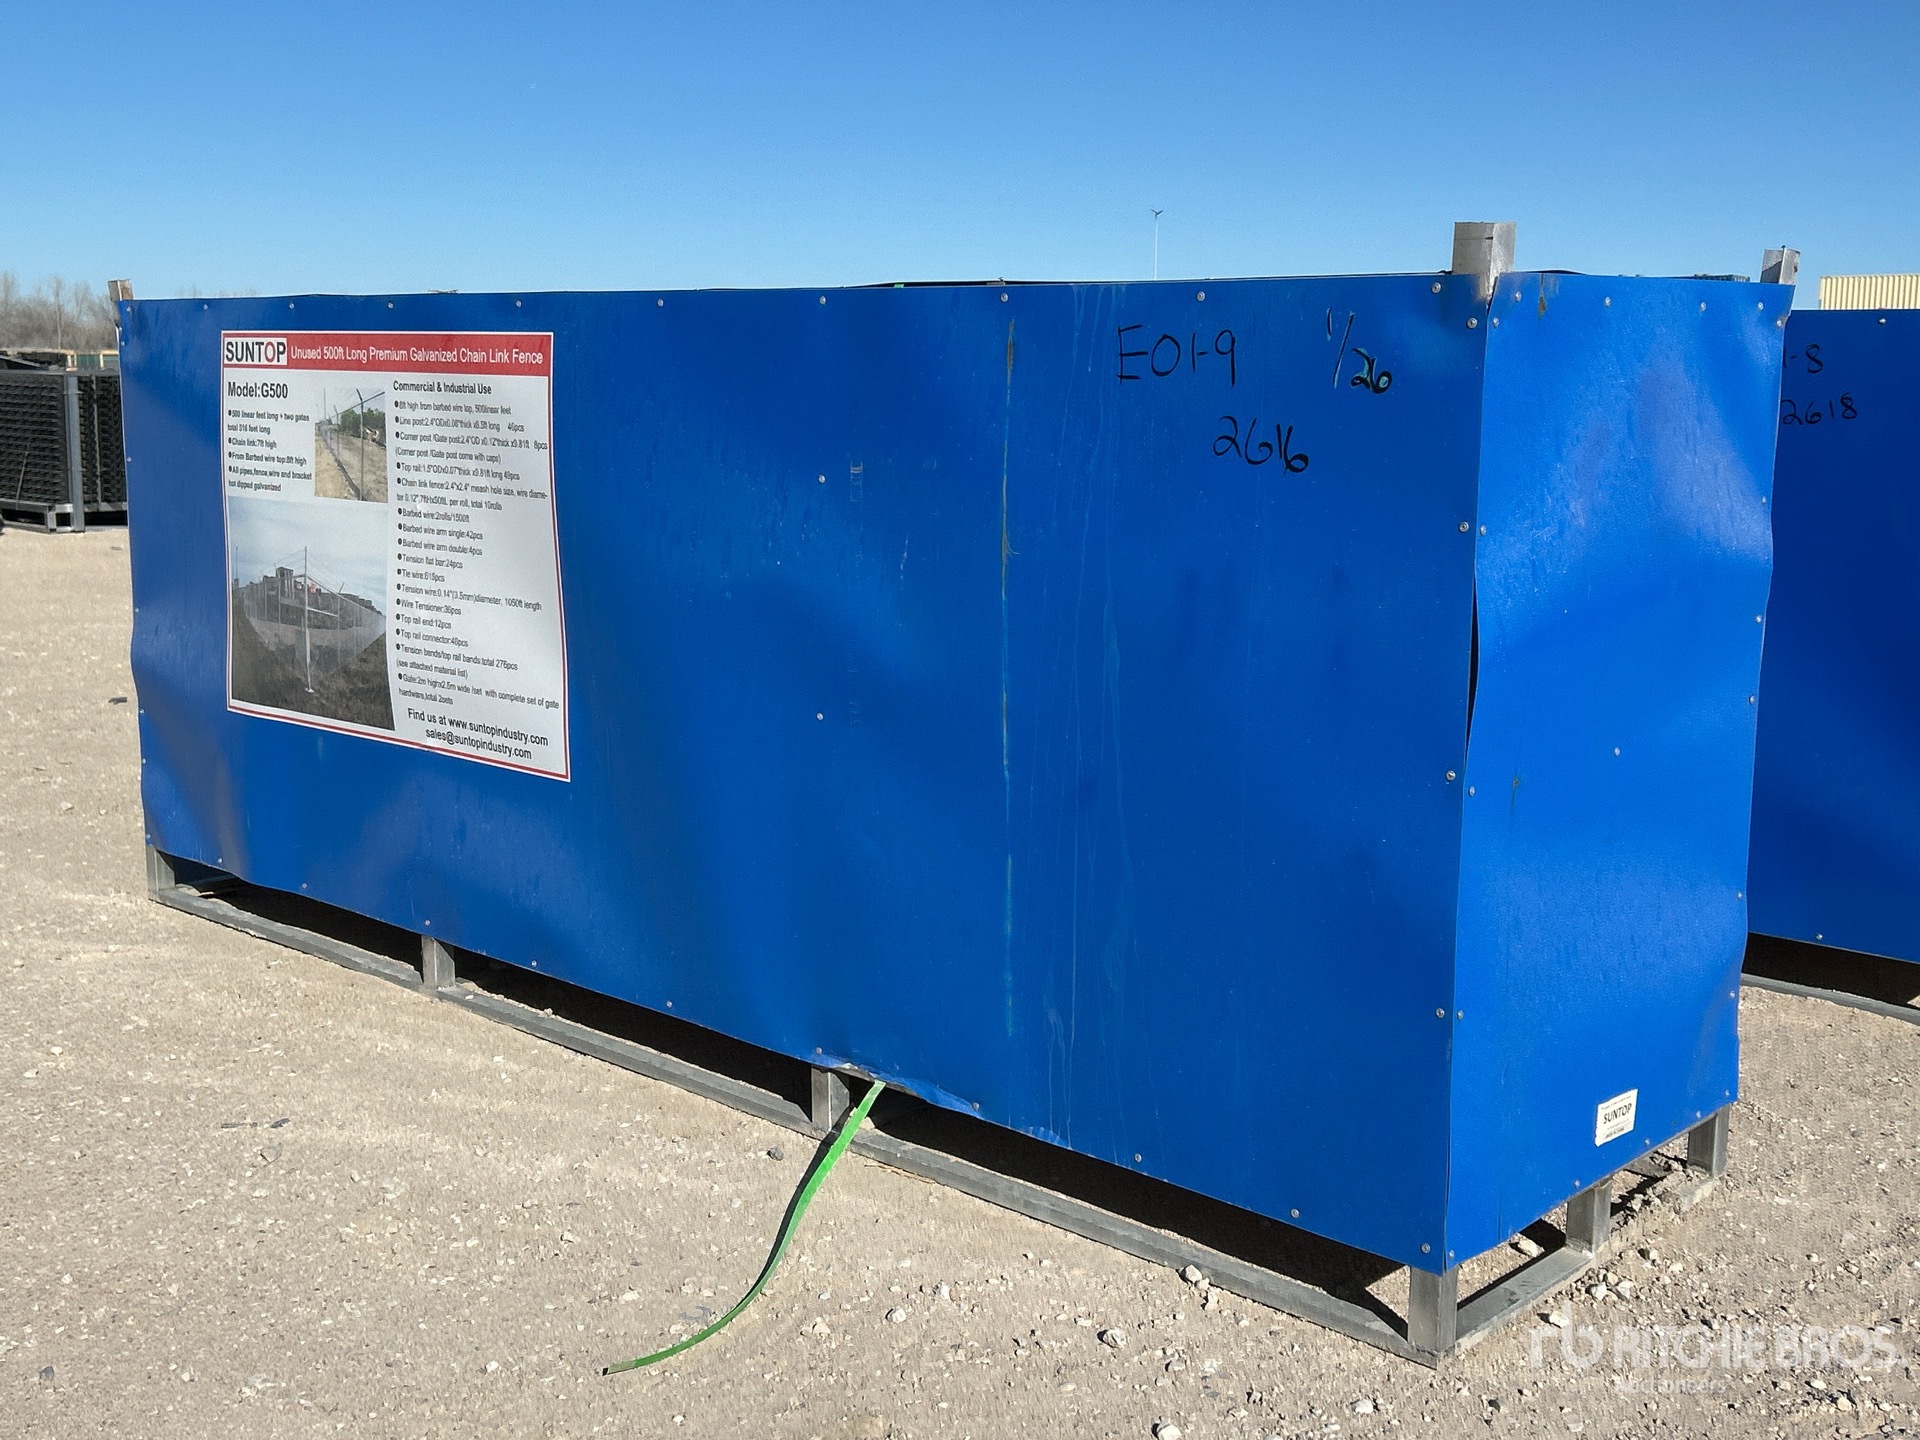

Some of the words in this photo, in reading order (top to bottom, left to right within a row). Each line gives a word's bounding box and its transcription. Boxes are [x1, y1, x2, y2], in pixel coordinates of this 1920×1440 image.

[225, 341, 286, 363] SUNTOP
[290, 345, 321, 359] Unused
[323, 346, 345, 360] 500ft
[346, 346, 367, 363] Long
[369, 346, 408, 361] Premium
[409, 347, 458, 363] Galvanized
[459, 347, 487, 363] Chain
[489, 348, 510, 364] Link
[512, 349, 543, 365] Fence
[227, 381, 289, 399] Model:G500
[393, 380, 435, 392] Commercial
[436, 381, 442, 393] &
[443, 382, 476, 394] Industrial
[477, 383, 492, 395] Use
[407, 401, 418, 412] high
[419, 402, 432, 411] from
[432, 403, 452, 412] barbed
[452, 404, 463, 412] wire
[500, 405, 512, 415] feet
[1781, 392, 1858, 426] 2618
[241, 410, 255, 419] linear
[255, 410, 266, 420] feet
[266, 411, 279, 422] long
[283, 412, 294, 421] two
[295, 414, 310, 423] gates
[400, 417, 411, 425] Line
[488, 421, 501, 432] long
[227, 424, 238, 432] total
[248, 424, 259, 433] feet
[259, 425, 271, 435] long
[231, 438, 246, 447] Chain
[264, 439, 277, 450] high
[400, 431, 418, 441] Corner
[419, 433, 432, 443] post
[533, 440, 548, 452] 8pcs
[1213, 415, 1310, 476] 2616
[231, 451, 245, 460] From
[245, 452, 264, 462] Barbed
[264, 454, 276, 463] wire
[294, 456, 308, 467] high
[395, 446, 416, 457] (Corner
[416, 449, 429, 459] post
[445, 451, 458, 461] post
[458, 453, 474, 461] come
[474, 452, 485, 462] with
[231, 465, 239, 474] All
[280, 469, 292, 479] and
[291, 470, 313, 481] bracket
[400, 462, 412, 473] Top
[490, 469, 503, 481] long
[236, 480, 254, 490] dipped
[253, 481, 282, 492] galvanized
[401, 477, 418, 487] Chain
[417, 479, 429, 489] link
[489, 485, 502, 495] hole
[516, 488, 528, 498] wire
[449, 498, 459, 507] per
[470, 499, 483, 509] total
[402, 507, 422, 519] Barbed
[402, 523, 423, 534] Barbed
[423, 525, 436, 535] wire
[435, 528, 448, 536] arm
[402, 538, 423, 549] Barbed
[423, 540, 436, 550] wire
[435, 543, 448, 552] arm
[402, 553, 425, 565] Tension
[425, 556, 435, 566] flat
[401, 568, 411, 578] Tie
[400, 598, 414, 609] Wire
[401, 583, 424, 595] Tension
[523, 599, 542, 612] length
[400, 613, 412, 625] Top
[412, 616, 421, 625] rail
[400, 628, 412, 640] Top
[412, 631, 421, 640] rail
[400, 643, 423, 656] Tension
[452, 652, 462, 662] rail
[462, 653, 480, 665] bands
[480, 657, 494, 667] total
[495, 658, 518, 671] 276pcs
[396, 657, 409, 669] (see
[409, 660, 434, 672] attached
[433, 665, 457, 676] material
[456, 684, 471, 694] wide
[484, 688, 498, 699] with
[498, 690, 526, 704] complete
[526, 696, 537, 706] set
[537, 697, 545, 707] of
[544, 699, 560, 710] gate
[407, 707, 426, 723] Find
[426, 713, 437, 724] us
[438, 714, 448, 727] at
[448, 717, 549, 747] www.suntopindustry.com
[425, 728, 532, 760] sales@suntopindustry.com
[1603, 1102, 1633, 1125] SUNTOP
